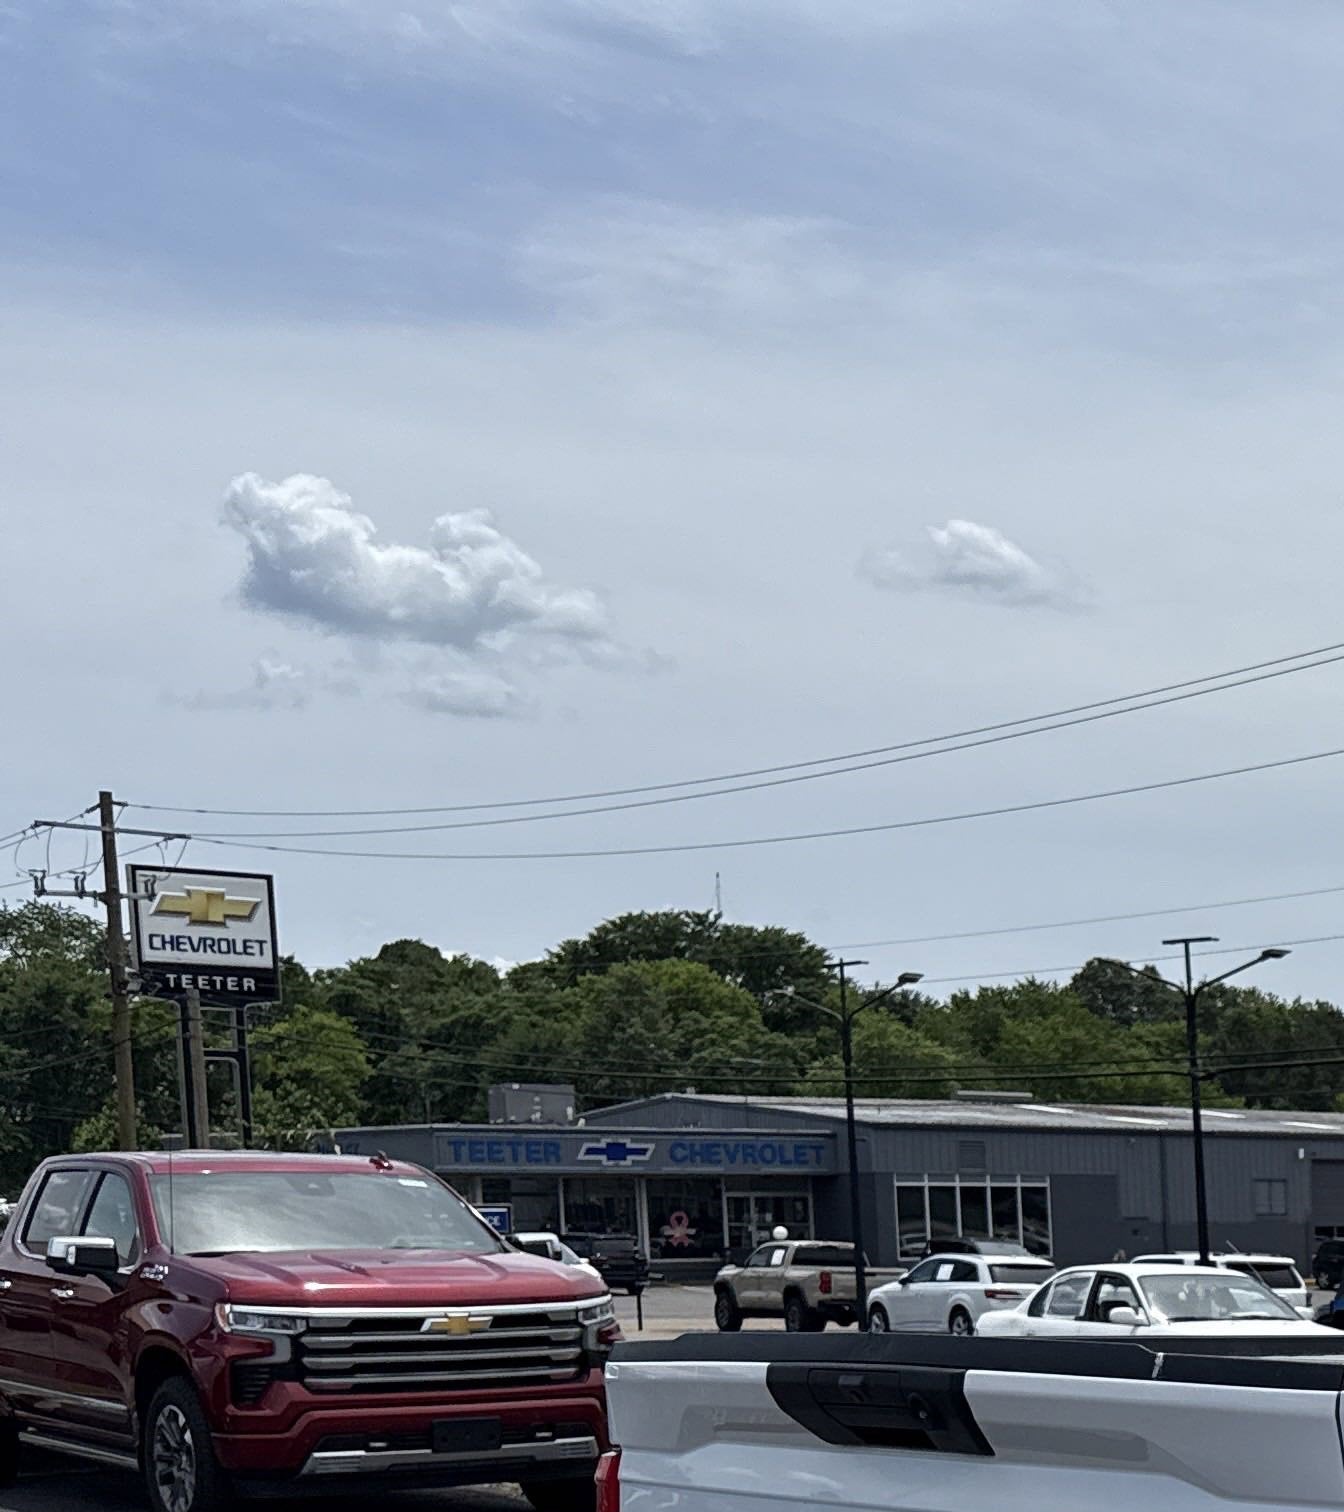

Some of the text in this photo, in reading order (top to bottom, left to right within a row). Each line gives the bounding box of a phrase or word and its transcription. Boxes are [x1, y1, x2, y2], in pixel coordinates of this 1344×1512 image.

[148, 933, 268, 957] CHEVROLET
[165, 973, 256, 992] TEETER
[448, 1139, 825, 1166] TEETER CHEVROLET
